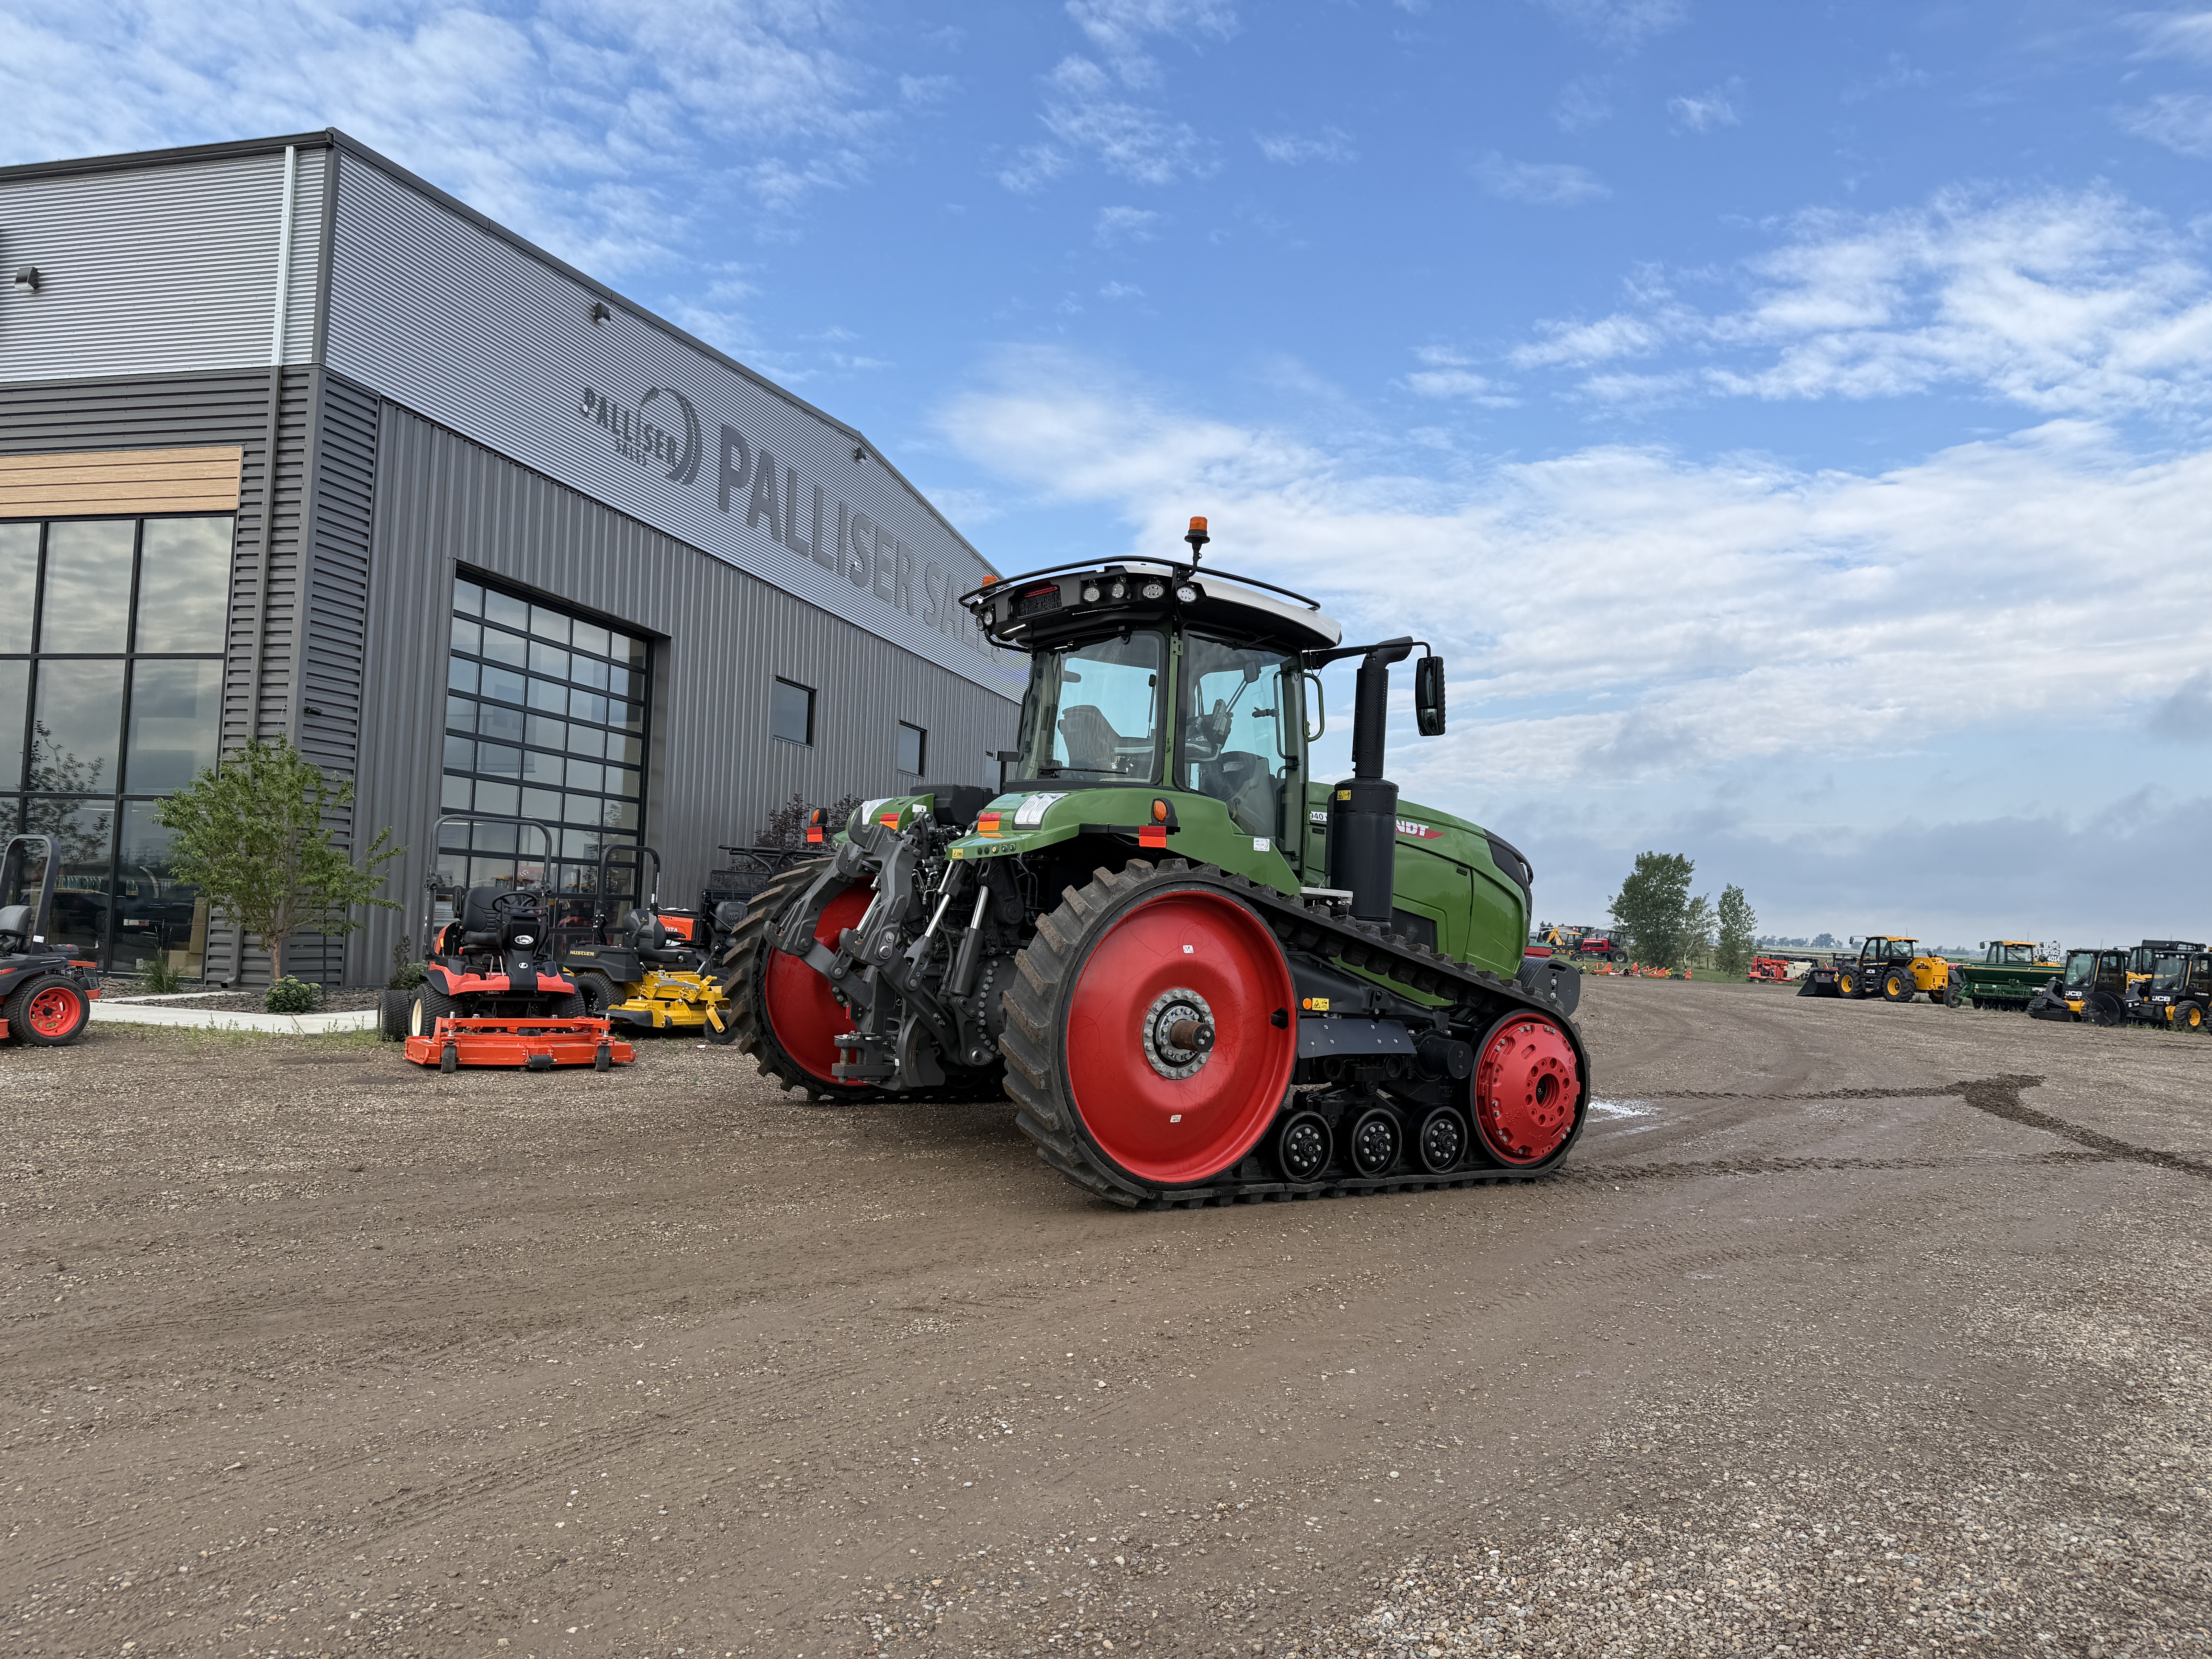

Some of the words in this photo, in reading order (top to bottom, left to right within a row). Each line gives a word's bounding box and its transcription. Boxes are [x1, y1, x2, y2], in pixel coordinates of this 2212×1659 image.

[584, 387, 678, 468] PALLISER
[719, 424, 915, 617] PALLISER
[1396, 819, 1429, 836] NDT
